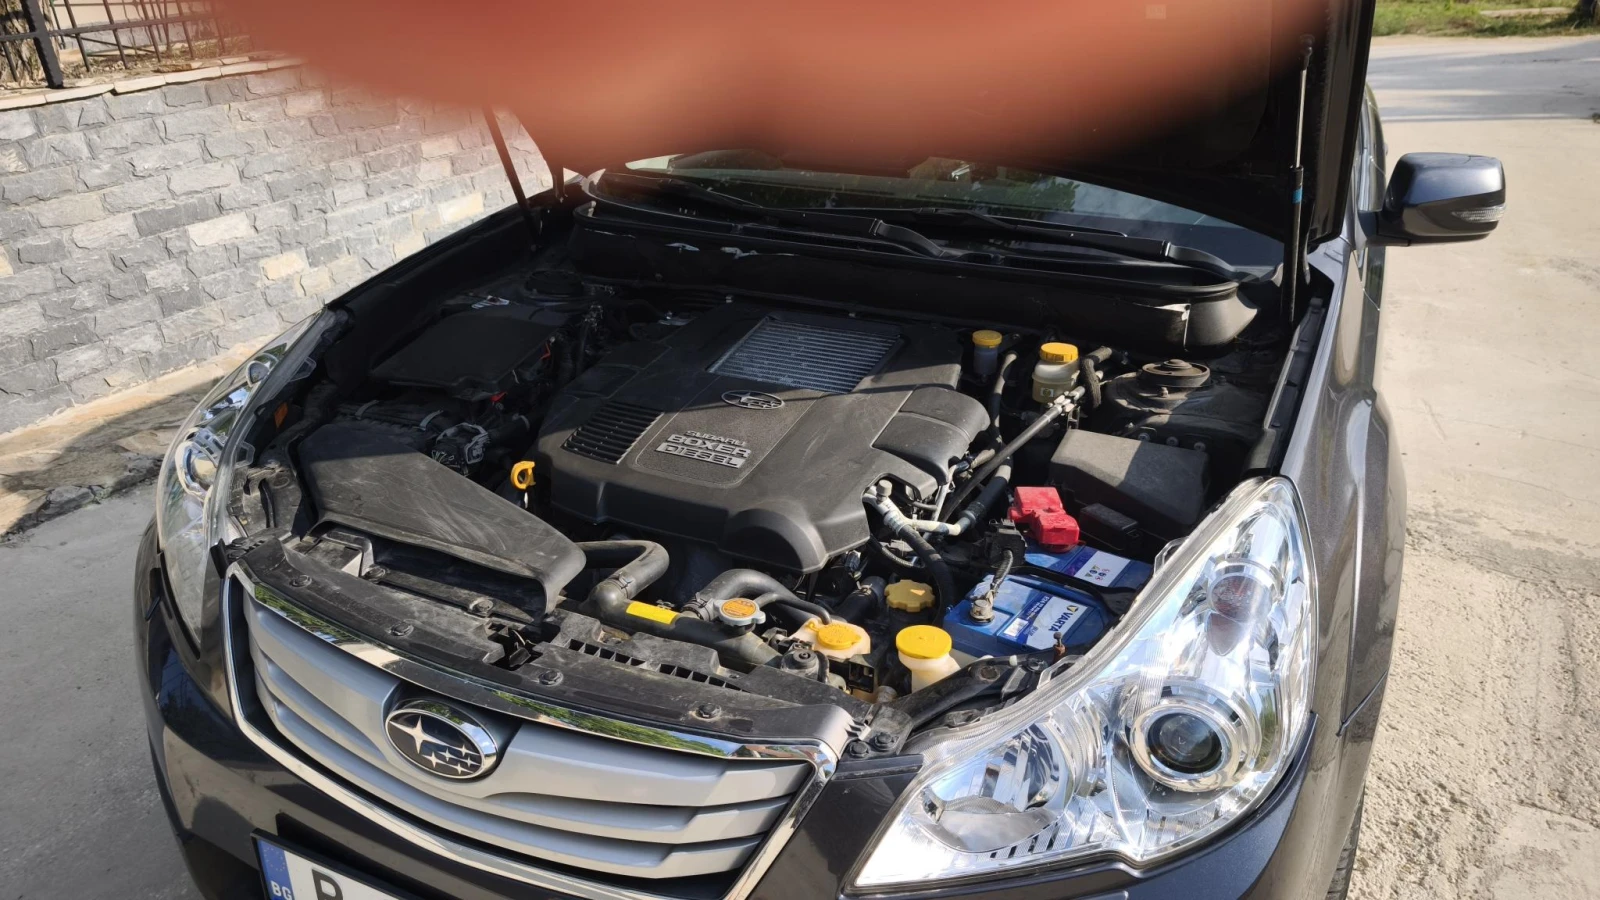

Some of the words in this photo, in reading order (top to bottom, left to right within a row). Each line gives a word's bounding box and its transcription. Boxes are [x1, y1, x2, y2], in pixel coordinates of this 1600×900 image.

[667, 433, 752, 458] BOXER
[684, 430, 747, 447] SUBARU
[662, 443, 741, 467] DIESEL
[1048, 611, 1073, 632] VARTA
[270, 880, 292, 900] BG
